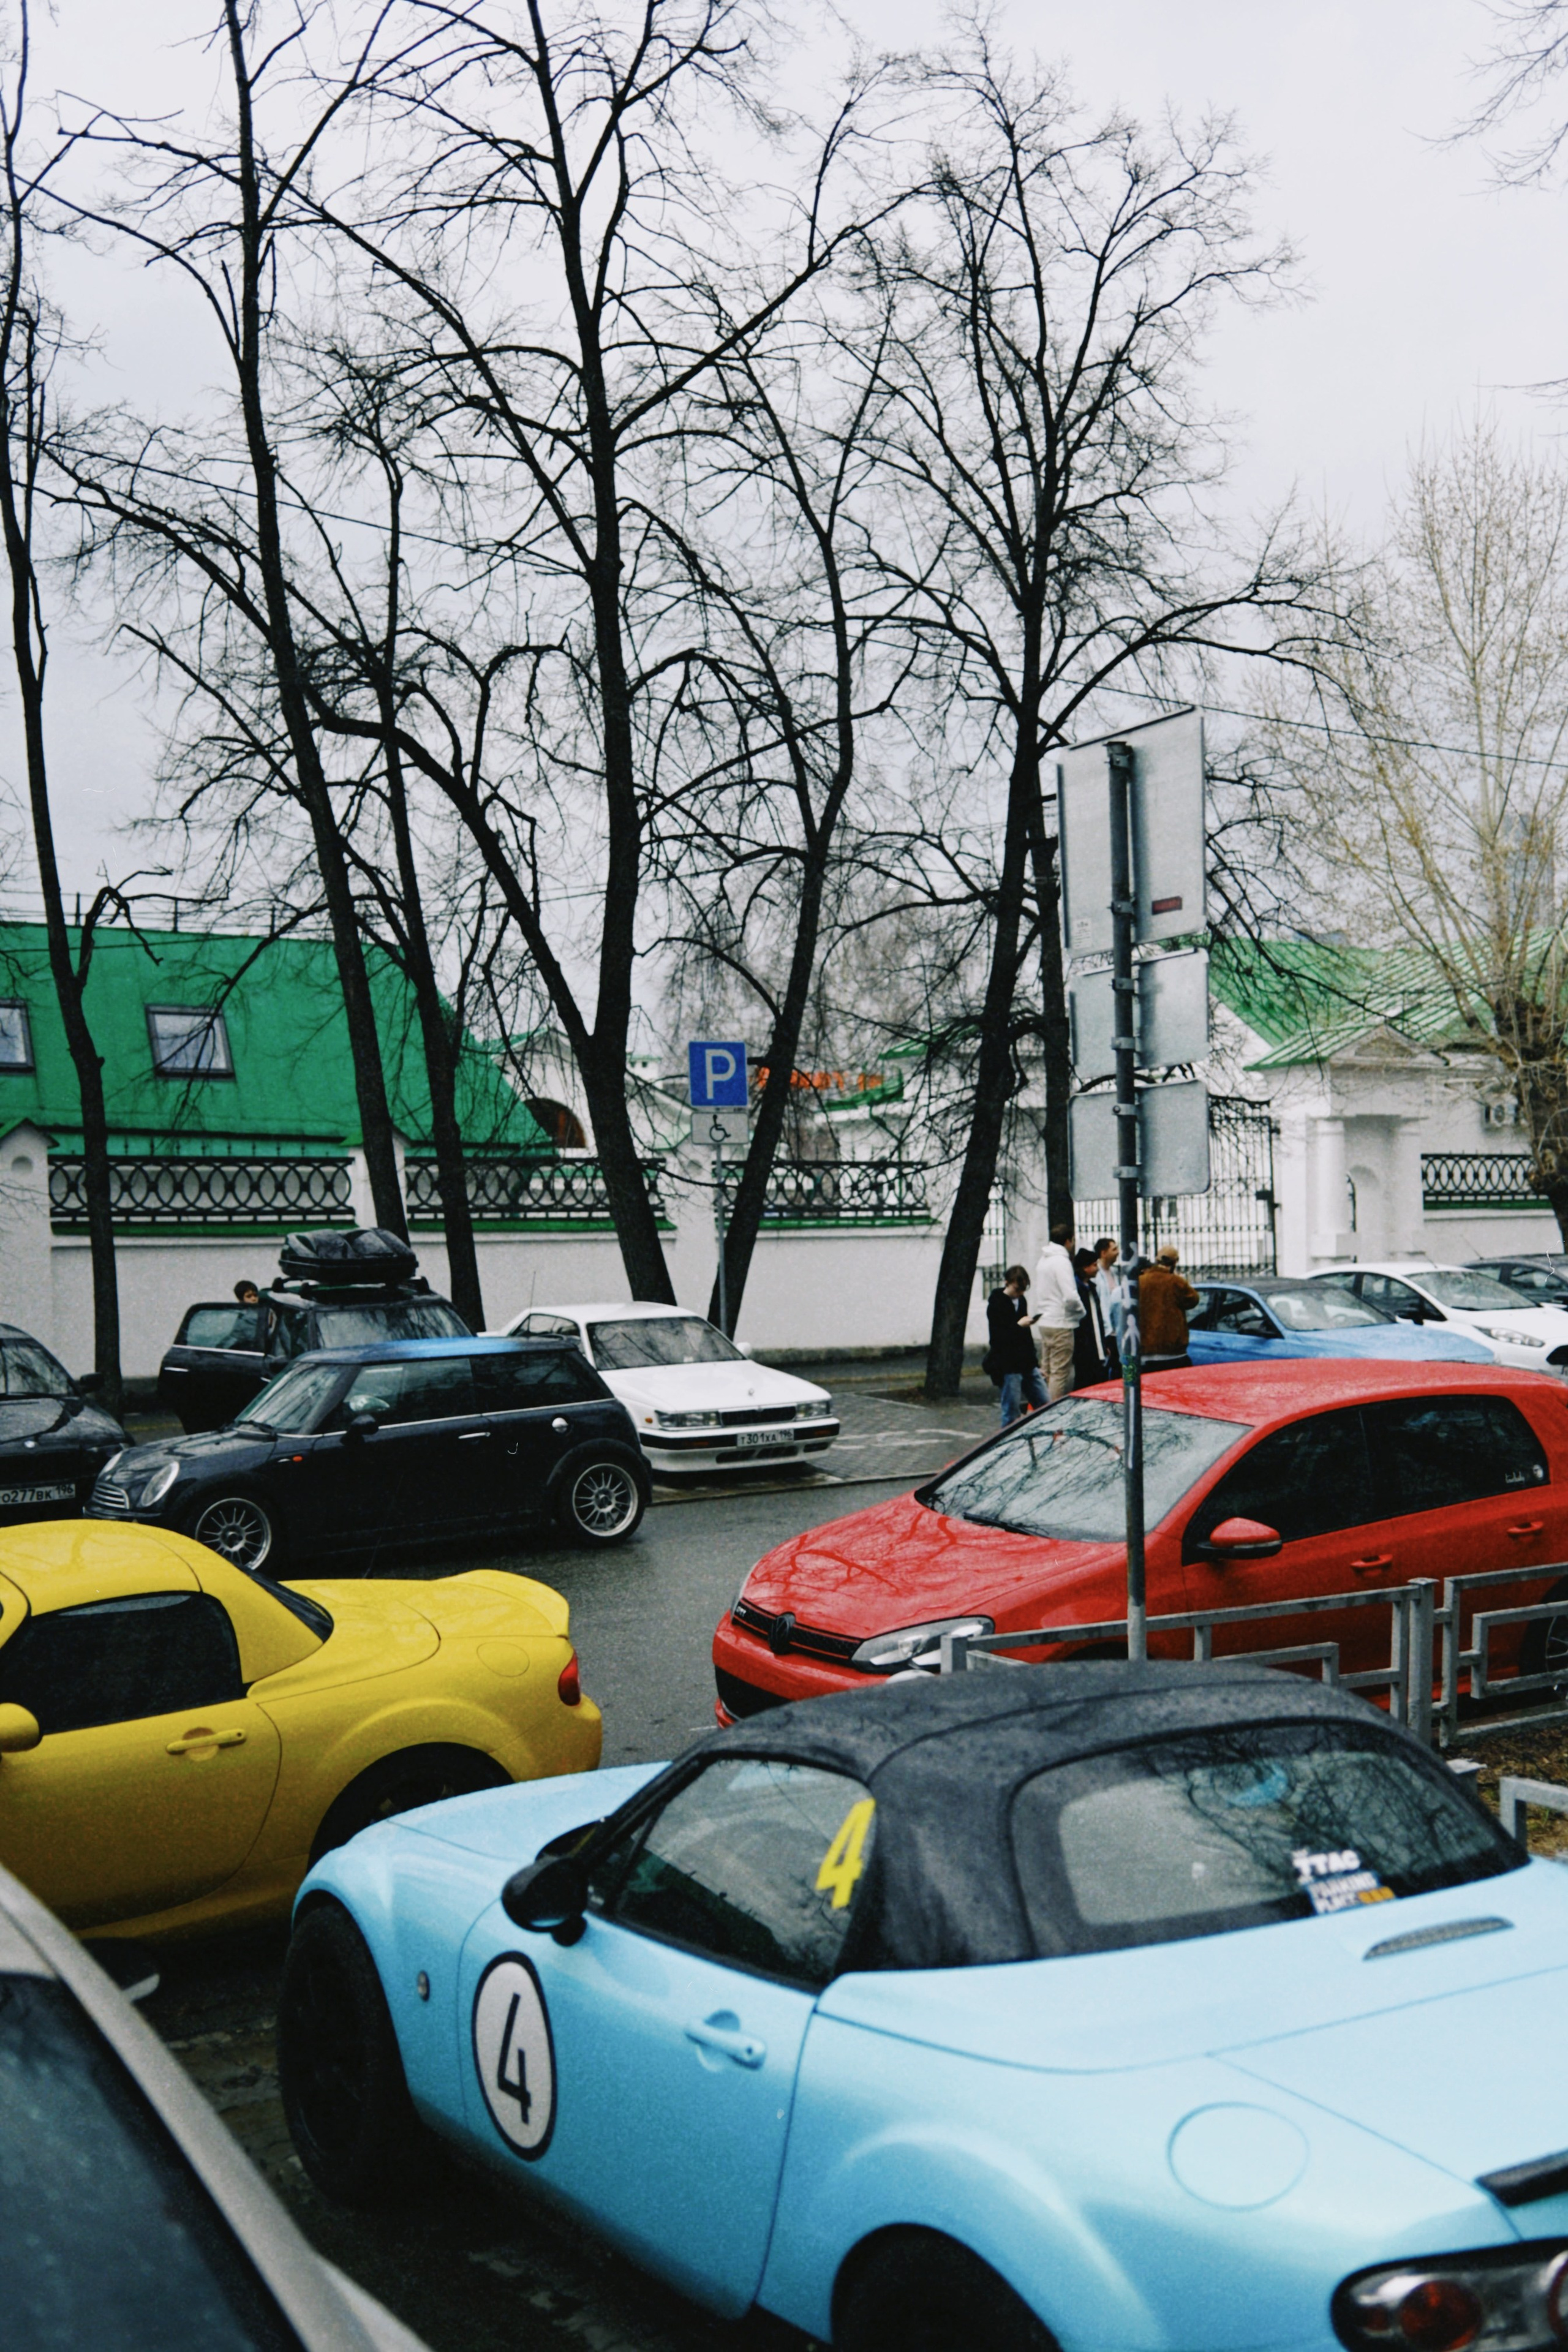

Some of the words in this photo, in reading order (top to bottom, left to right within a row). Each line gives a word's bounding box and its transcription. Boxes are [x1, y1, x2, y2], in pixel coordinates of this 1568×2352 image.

[705, 1049, 736, 1099] P
[56, 1484, 74, 1494] 196
[815, 1797, 876, 1910] 4
[497, 1992, 531, 2125] 4
